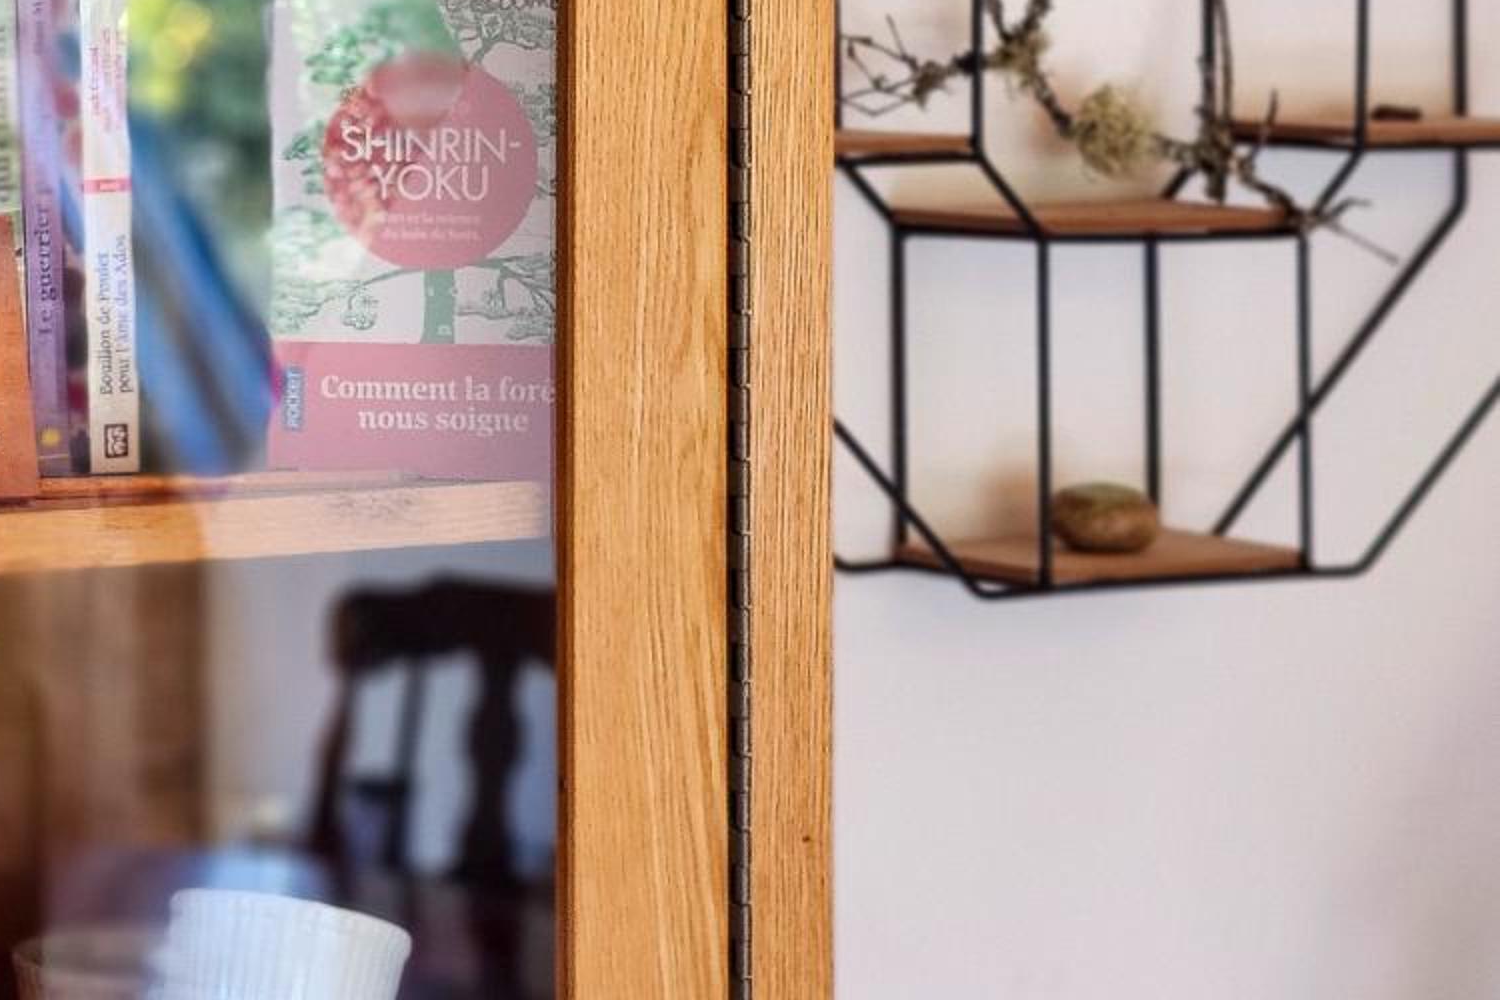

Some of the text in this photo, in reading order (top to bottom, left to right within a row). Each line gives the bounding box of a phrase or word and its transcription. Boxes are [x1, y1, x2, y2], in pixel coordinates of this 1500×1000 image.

[340, 125, 522, 164] SHINRIN-
[372, 164, 489, 200] YOKU
[320, 375, 456, 402] Comment
[465, 376, 491, 402] la
[358, 407, 530, 437] nous soigne
